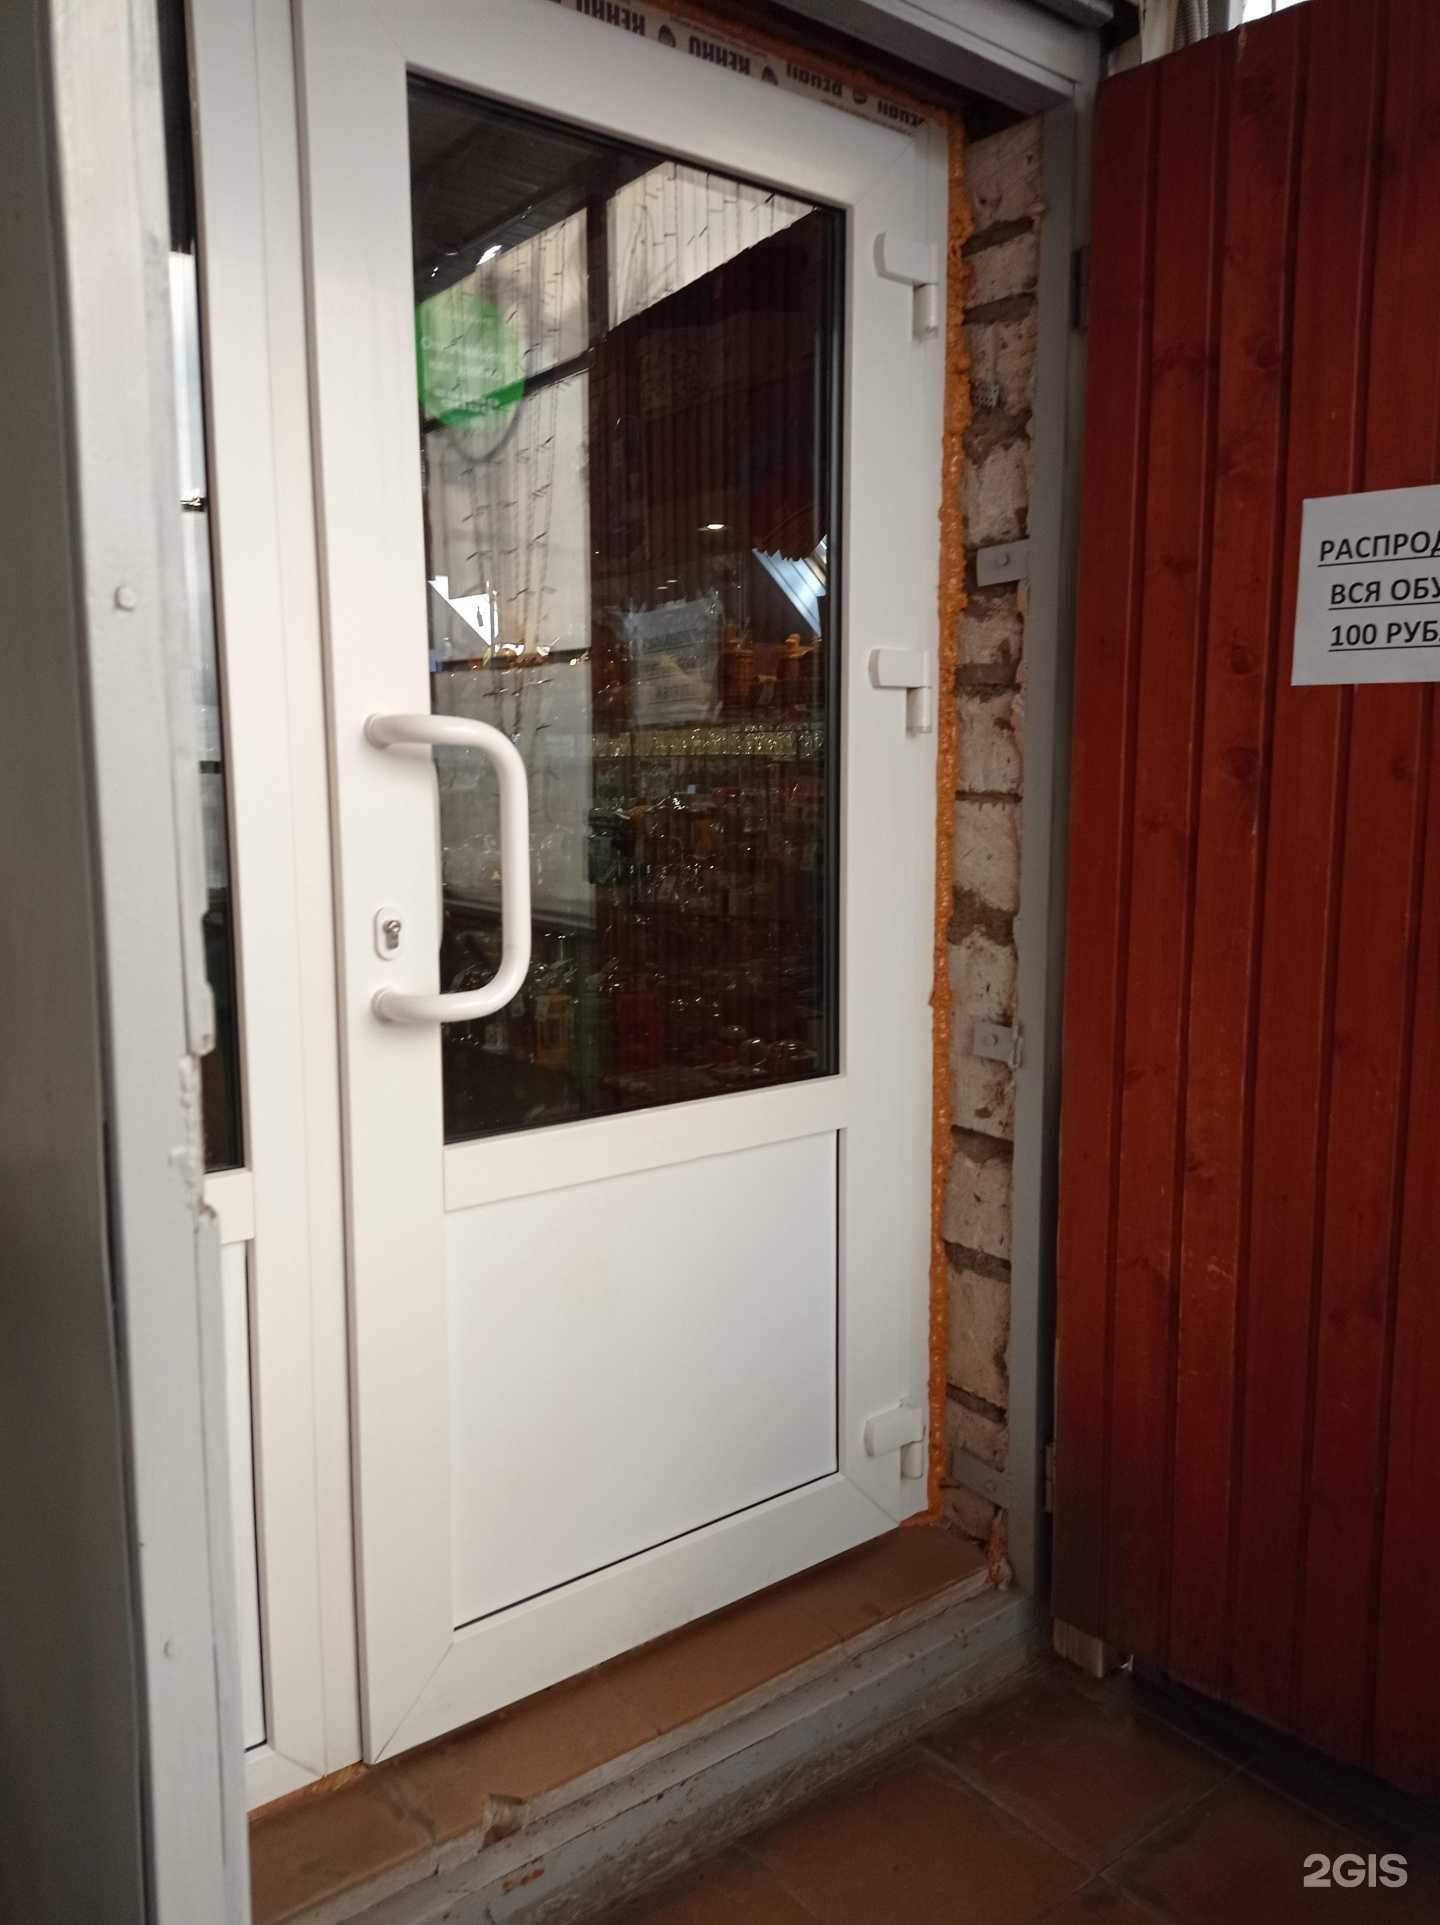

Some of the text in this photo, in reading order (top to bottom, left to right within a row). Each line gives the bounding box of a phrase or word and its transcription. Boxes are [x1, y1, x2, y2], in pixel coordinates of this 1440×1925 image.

[1331, 581, 1381, 605] ВСЯ
[1331, 620, 1440, 647] 100 РУБ
